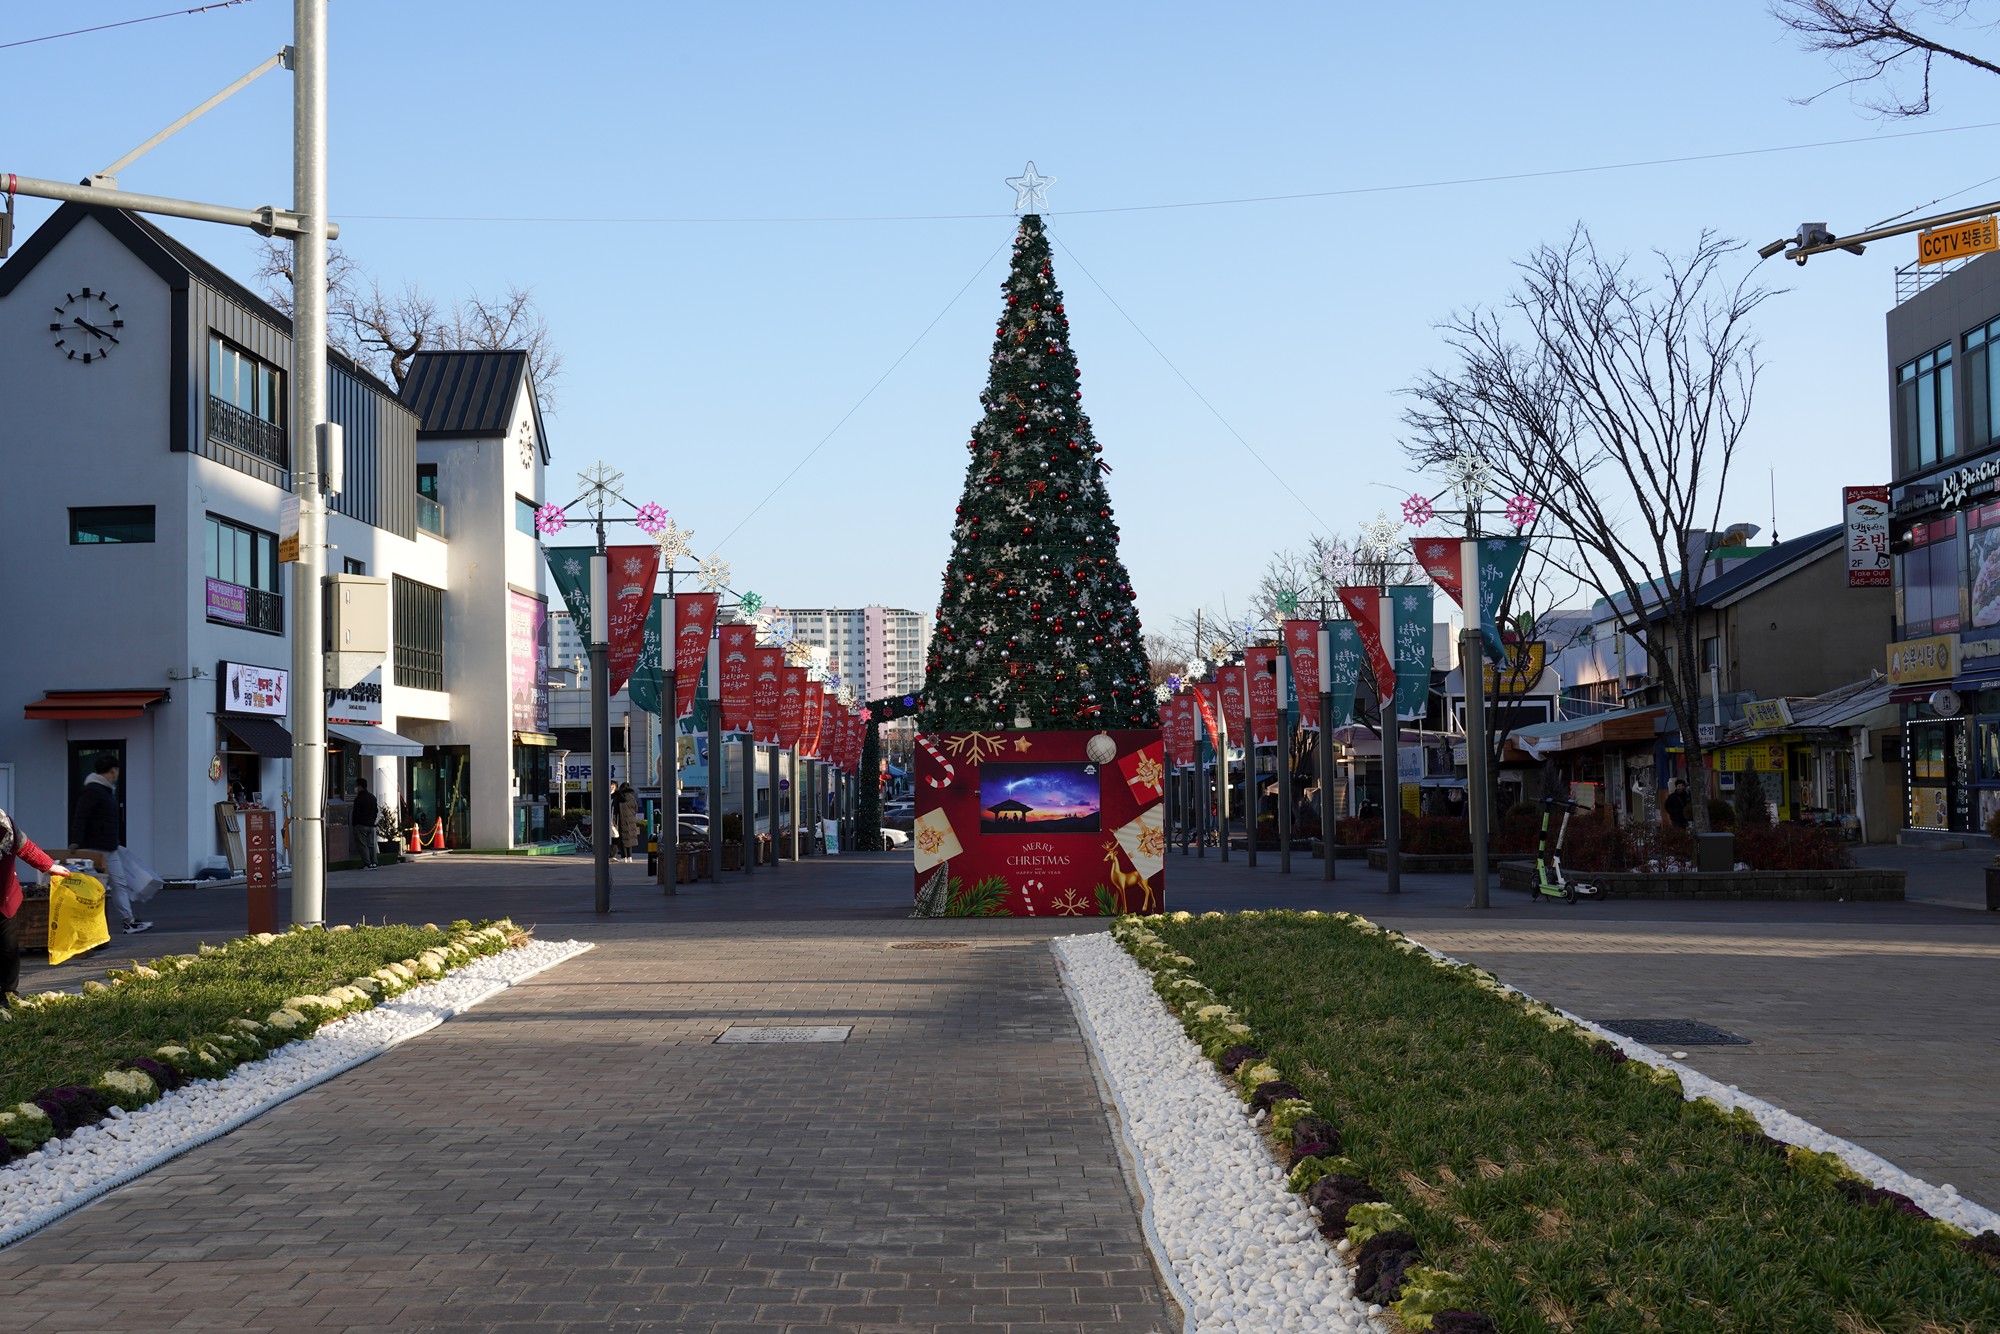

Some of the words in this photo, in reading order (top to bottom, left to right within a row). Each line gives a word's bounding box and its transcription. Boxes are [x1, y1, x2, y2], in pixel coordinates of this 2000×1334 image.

[1924, 233, 1959, 256] CCTV
[1962, 226, 1992, 248] 작동중
[1851, 532, 1889, 552] 초밥
[1852, 559, 1863, 567] 2F
[1850, 577, 1890, 586] 645-5802
[1902, 643, 1936, 673] 송복식당
[1022, 842, 1055, 852] MERRY
[1006, 855, 1071, 866] CHRISTMAS
